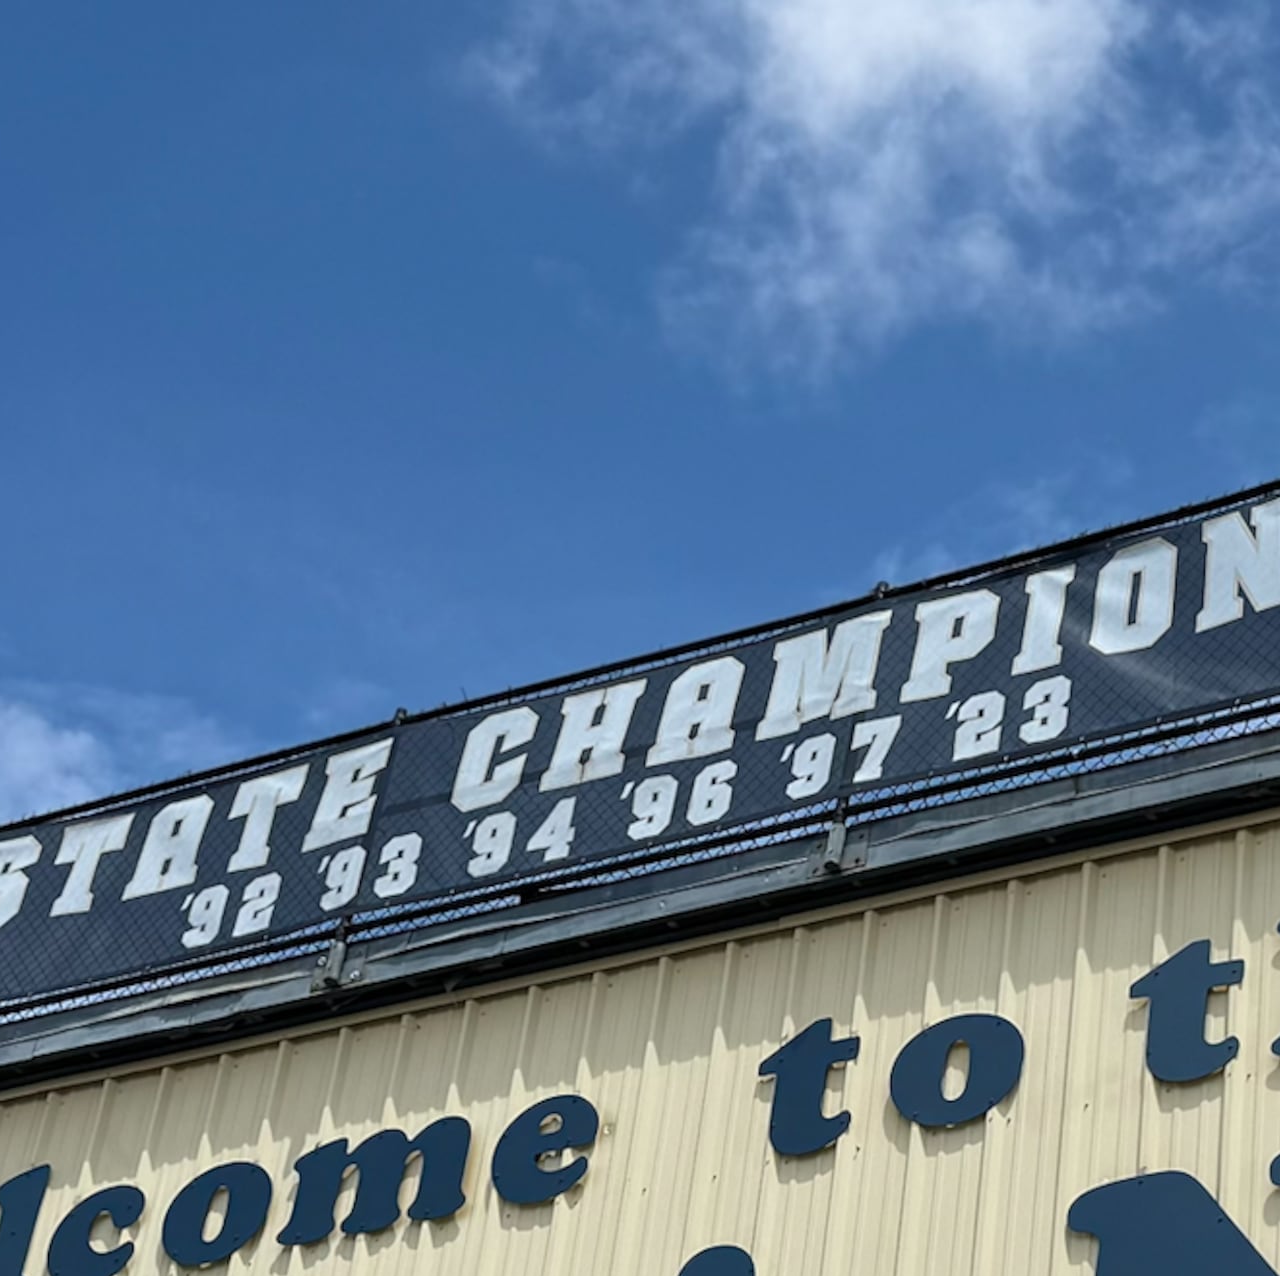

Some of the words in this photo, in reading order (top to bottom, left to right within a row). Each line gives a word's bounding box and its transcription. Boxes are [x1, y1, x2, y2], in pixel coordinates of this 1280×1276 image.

[179, 871, 283, 949] '92
[318, 831, 422, 912] '93
[462, 795, 577, 878] '94
[621, 758, 738, 841] '96
[780, 714, 902, 801] '97
[945, 674, 1072, 762] '23
[758, 1012, 1025, 1157] to
